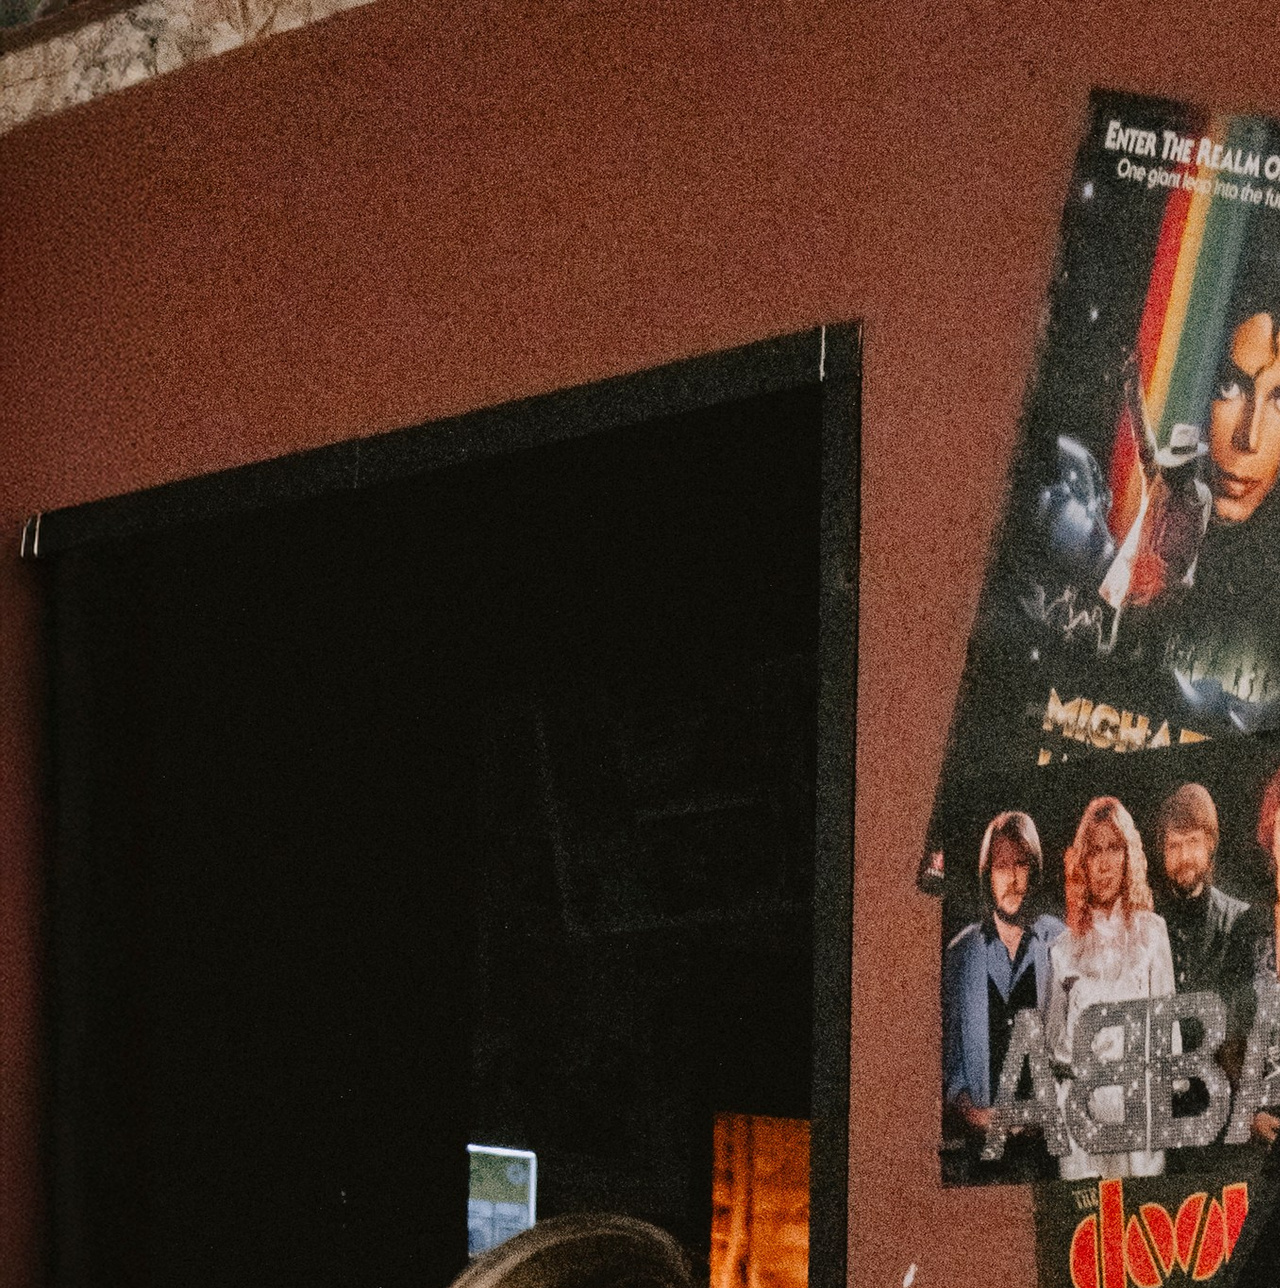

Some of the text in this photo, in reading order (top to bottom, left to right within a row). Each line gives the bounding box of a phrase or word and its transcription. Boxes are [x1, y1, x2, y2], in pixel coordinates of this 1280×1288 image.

[1105, 120, 1157, 157] ENTER
[1162, 130, 1195, 163] THE
[1196, 137, 1260, 177] REALM
[1117, 158, 1147, 181] One
[1147, 166, 1182, 189] giant
[1182, 171, 1213, 195] leap
[1214, 180, 1239, 200] into
[1240, 183, 1263, 204] the
